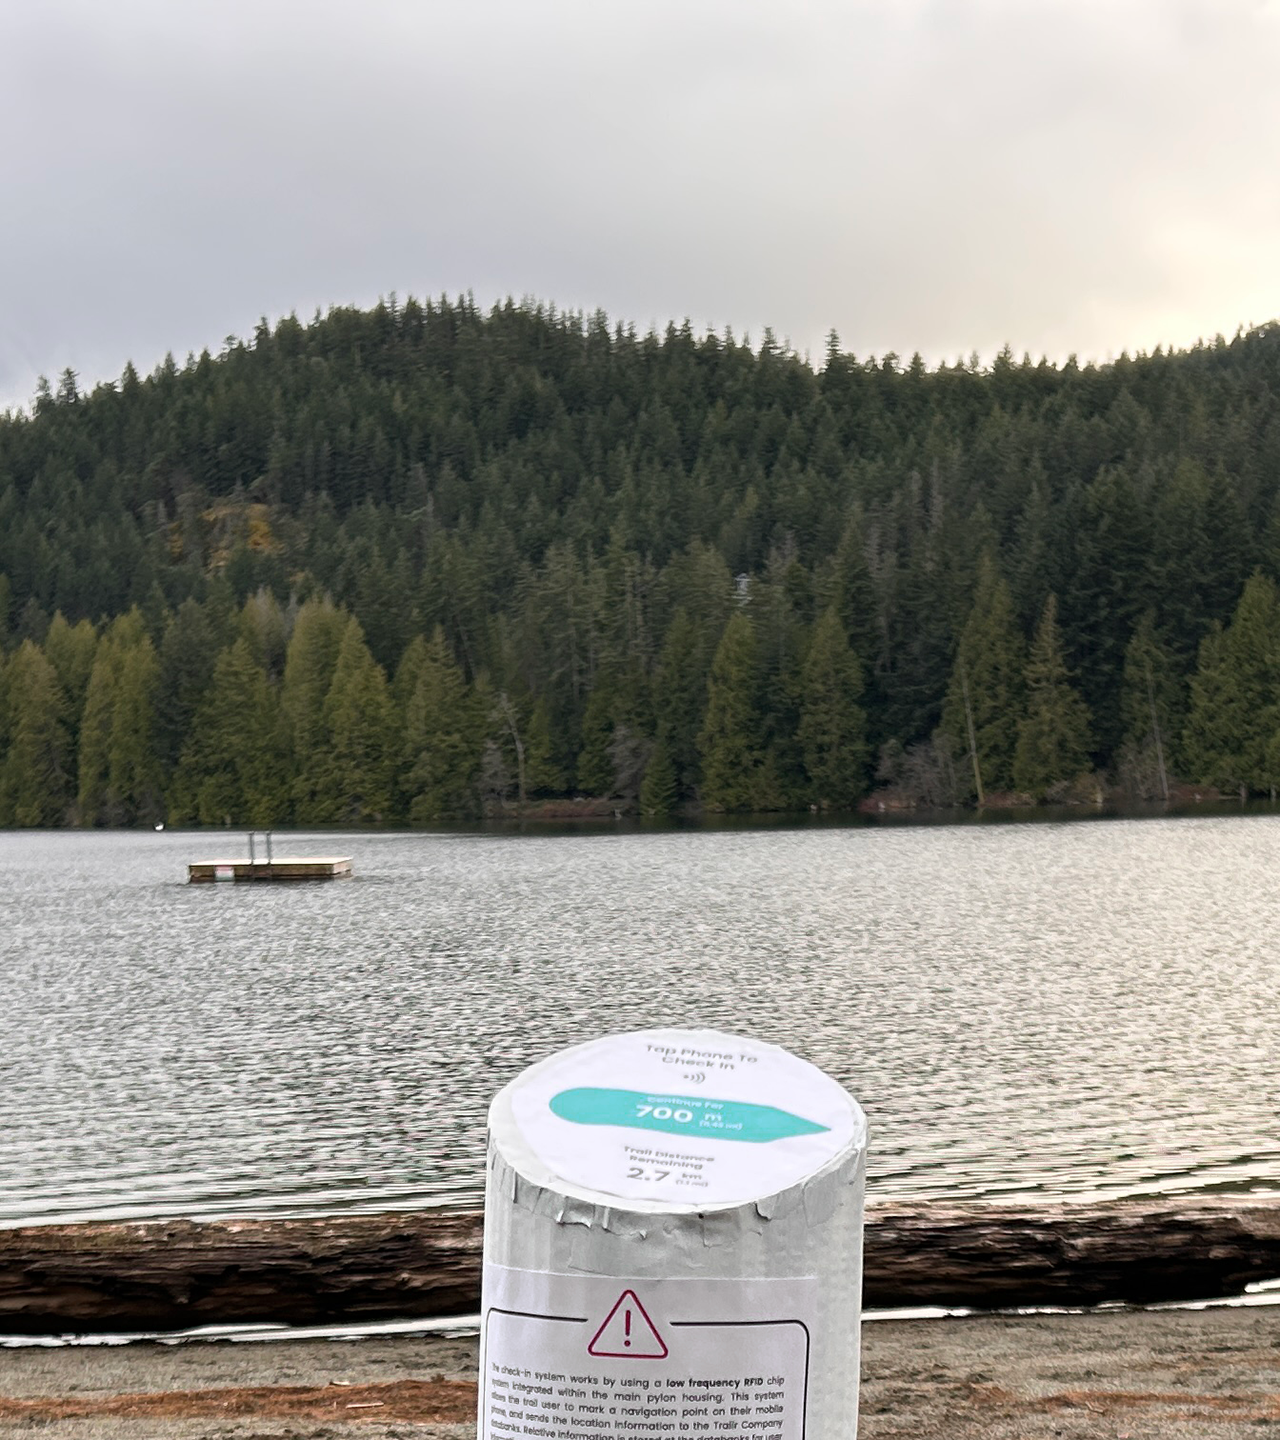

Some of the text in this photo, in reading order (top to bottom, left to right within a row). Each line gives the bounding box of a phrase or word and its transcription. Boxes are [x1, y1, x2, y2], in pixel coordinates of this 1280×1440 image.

[647, 1045, 758, 1063] Tap Phone To
[662, 1056, 735, 1070] Check In
[647, 1097, 702, 1108] Continue
[636, 1104, 722, 1123] 700 m
[624, 1145, 715, 1162] Trail Distance
[629, 1155, 703, 1170] Remaining
[626, 1167, 702, 1182] 2.7 km
[535, 1371, 566, 1382] system
[570, 1375, 599, 1385] works
[603, 1376, 616, 1389] by
[621, 1378, 649, 1390] using
[654, 1380, 661, 1388] a
[666, 1378, 685, 1388] low
[688, 1378, 740, 1390] frequency
[744, 1377, 763, 1387] RFID
[767, 1375, 785, 1388] chip
[512, 1381, 553, 1395] integrated
[558, 1388, 586, 1399] within
[591, 1390, 608, 1400] the
[614, 1392, 640, 1402] main
[647, 1393, 676, 1404] pylon
[682, 1392, 724, 1404] housing.
[731, 1392, 749, 1401] This
[754, 1391, 784, 1402] system
[523, 1397, 538, 1407] trail
[541, 1401, 560, 1410] user
[565, 1402, 574, 1412] to
[578, 1403, 605, 1414] mark
[609, 1406, 616, 1414] a
[621, 1406, 677, 1419] navigation
[682, 1407, 708, 1419] point
[712, 1408, 725, 1416] on
[730, 1406, 752, 1416] their
[755, 1405, 784, 1415] mobile
[509, 1410, 523, 1420] and
[526, 1412, 549, 1423] sends
[552, 1415, 567, 1425] the
[571, 1416, 611, 1429] location
[614, 1420, 675, 1431] information
[679, 1422, 689, 1431] to
[693, 1422, 709, 1431] the
[741, 1420, 783, 1431] Company
[523, 1426, 555, 1439] Relative
[765, 1433, 783, 1440] user
